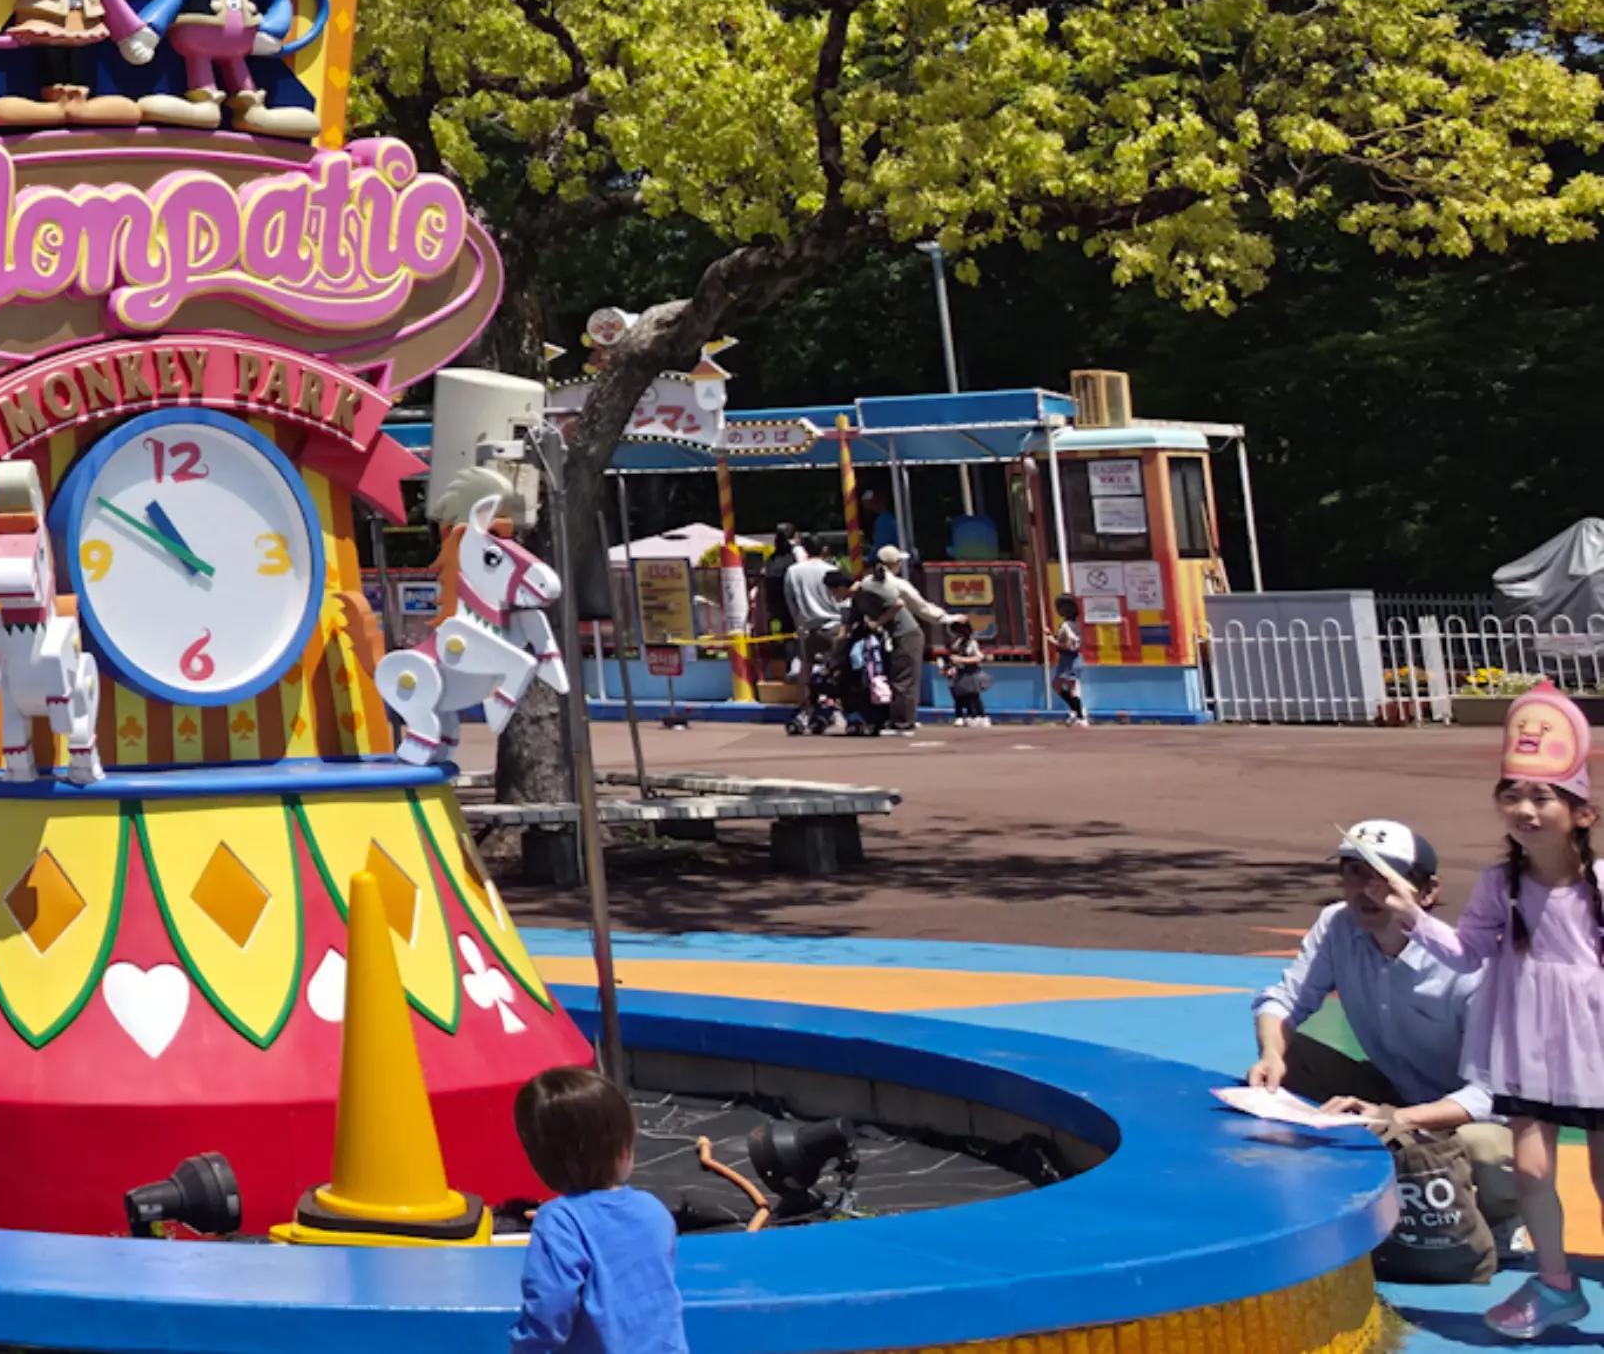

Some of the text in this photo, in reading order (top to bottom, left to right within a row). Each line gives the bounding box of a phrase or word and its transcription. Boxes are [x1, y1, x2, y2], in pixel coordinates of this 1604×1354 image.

[235, 351, 364, 435] PARK
[143, 437, 210, 484] 12
[78, 538, 114, 583] 9
[254, 532, 293, 576] 3
[178, 627, 215, 682] 6
